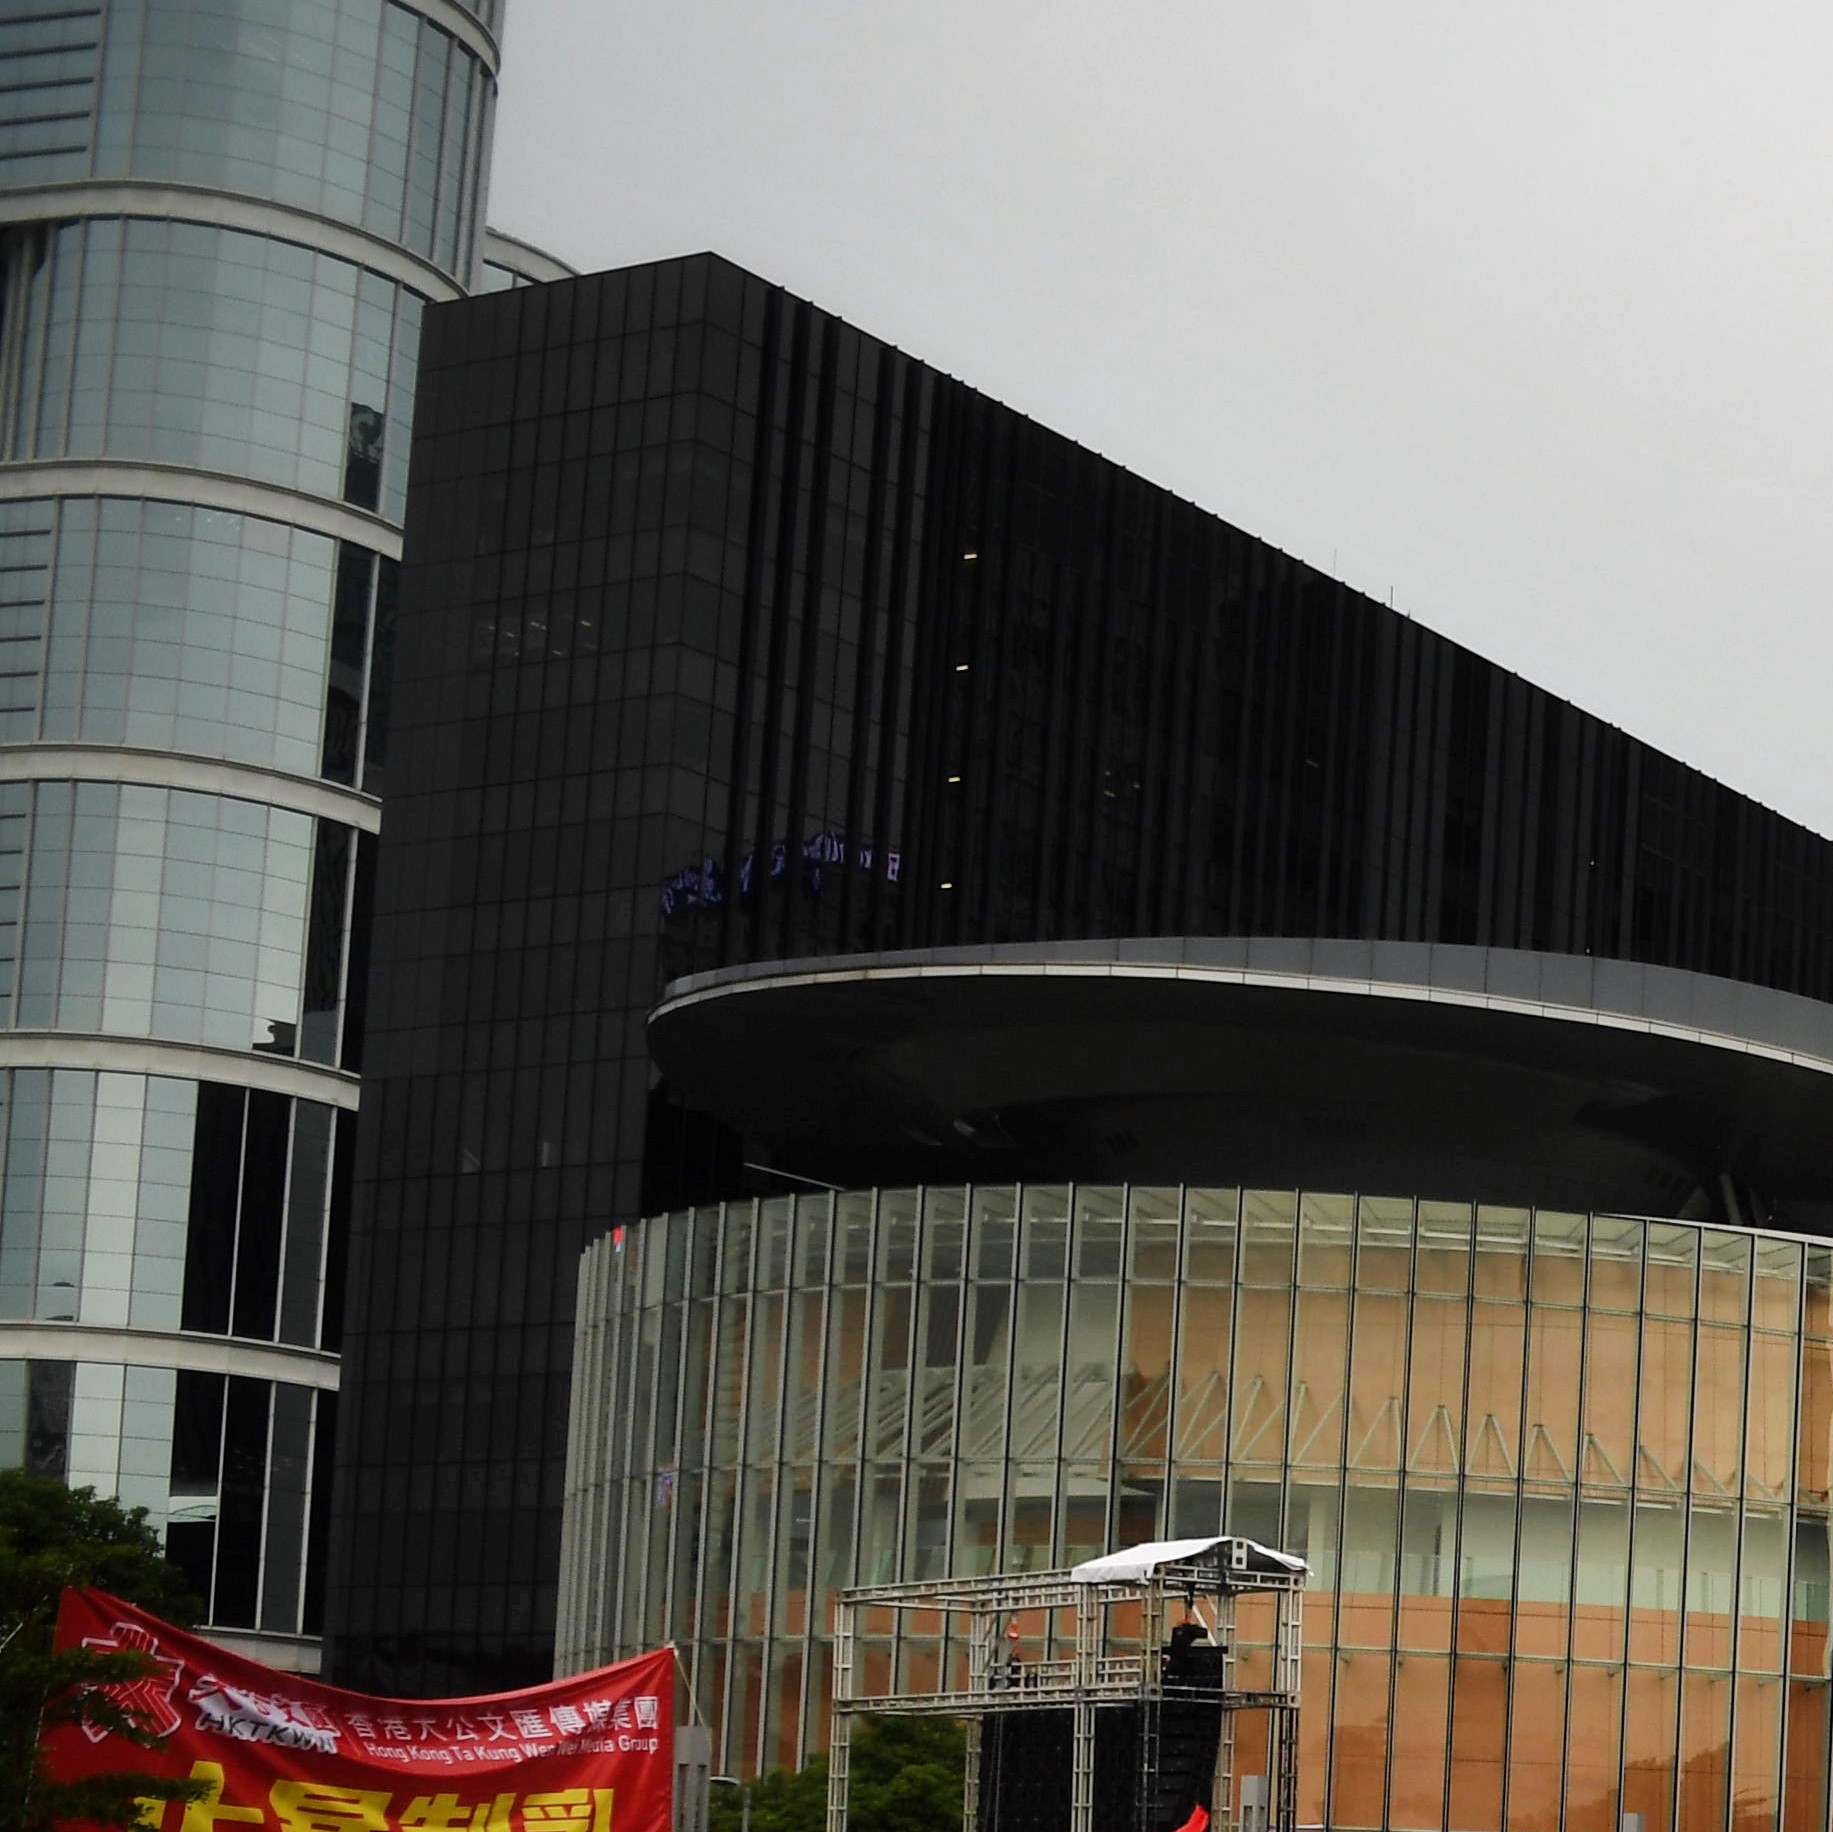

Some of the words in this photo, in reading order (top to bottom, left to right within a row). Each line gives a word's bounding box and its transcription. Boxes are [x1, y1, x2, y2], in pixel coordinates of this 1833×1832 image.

[364, 1742, 407, 1764] Hong
[409, 1745, 452, 1765] Kong
[453, 1746, 473, 1761] Ta
[474, 1745, 521, 1764] Kung
[618, 1735, 659, 1755] Group
